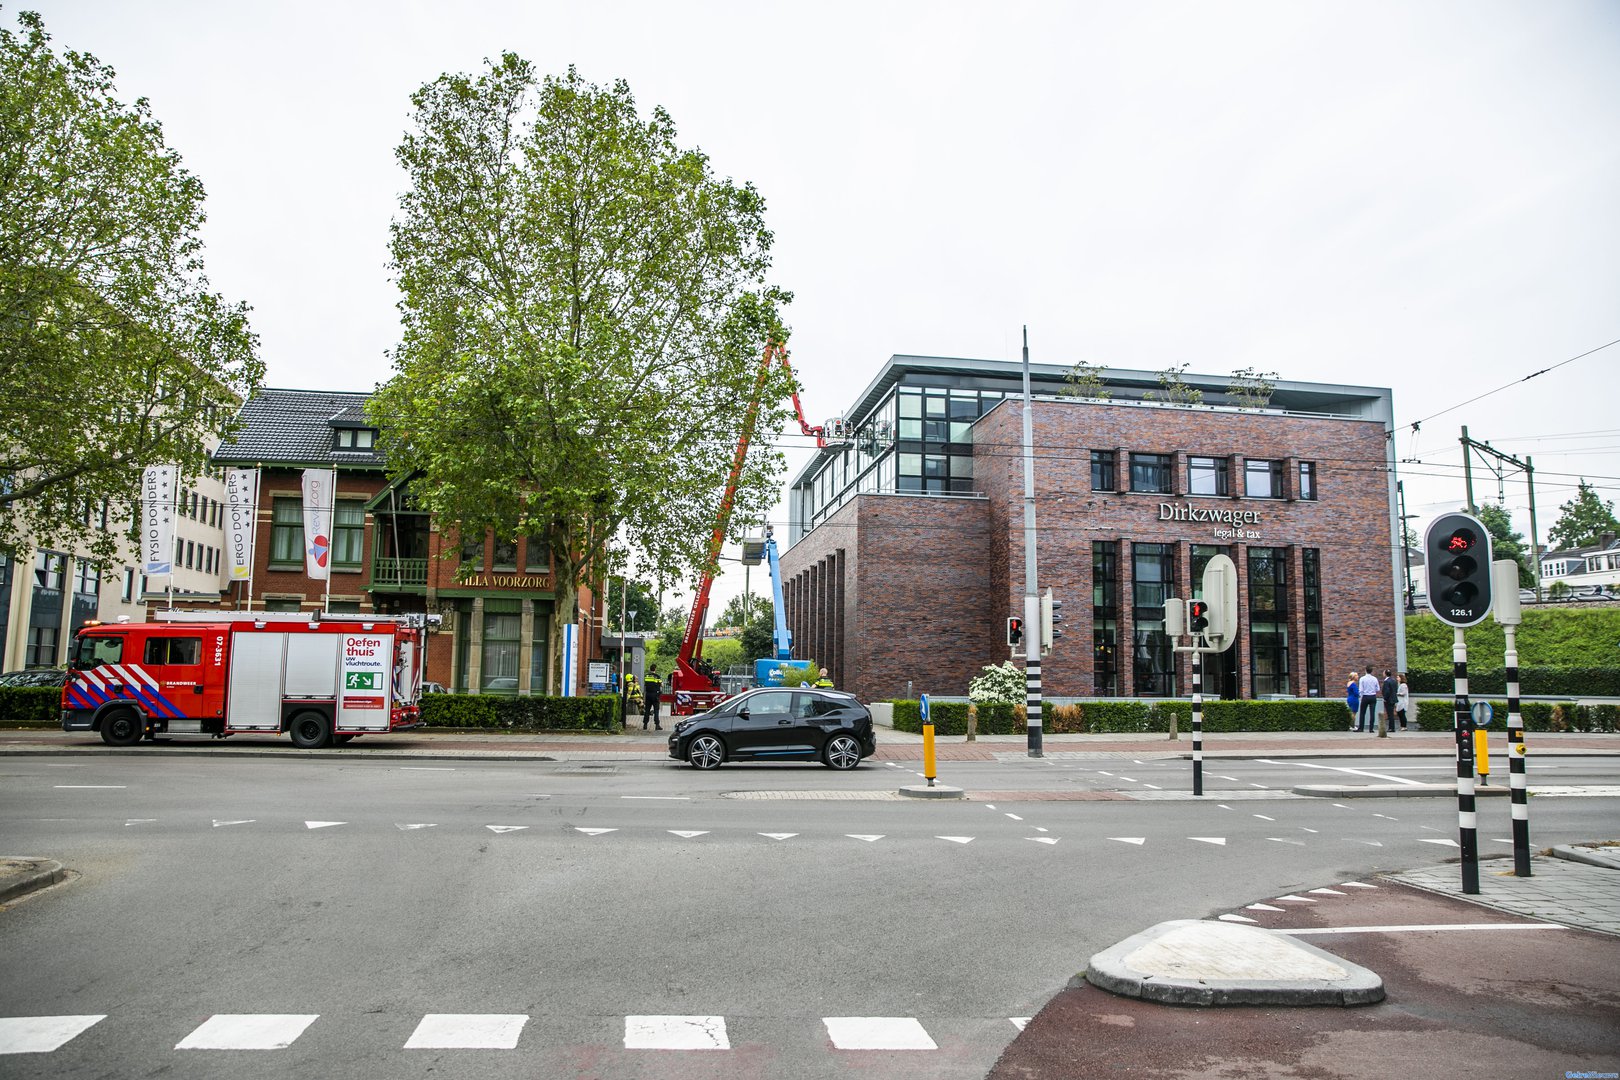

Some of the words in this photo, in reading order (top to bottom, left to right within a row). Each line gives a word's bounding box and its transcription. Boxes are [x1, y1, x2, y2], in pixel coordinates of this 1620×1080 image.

[147, 470, 158, 526] DONDERS
[228, 473, 241, 530] DONDERS
[310, 480, 321, 535] RevaZorg
[1159, 503, 1260, 527] Dirkzwager
[149, 529, 160, 562] FYSIO
[1214, 527, 1235, 540] legal
[1236, 529, 1245, 538] &
[1247, 530, 1261, 539] tax
[234, 533, 244, 565] ERGO
[492, 576, 550, 588] VOORZORG
[346, 637, 381, 647] Oefen
[684, 610, 697, 644] BRANDWEER
[214, 636, 224, 666] 07-3631
[346, 647, 375, 657] thuis
[633, 655, 640, 663] 8
